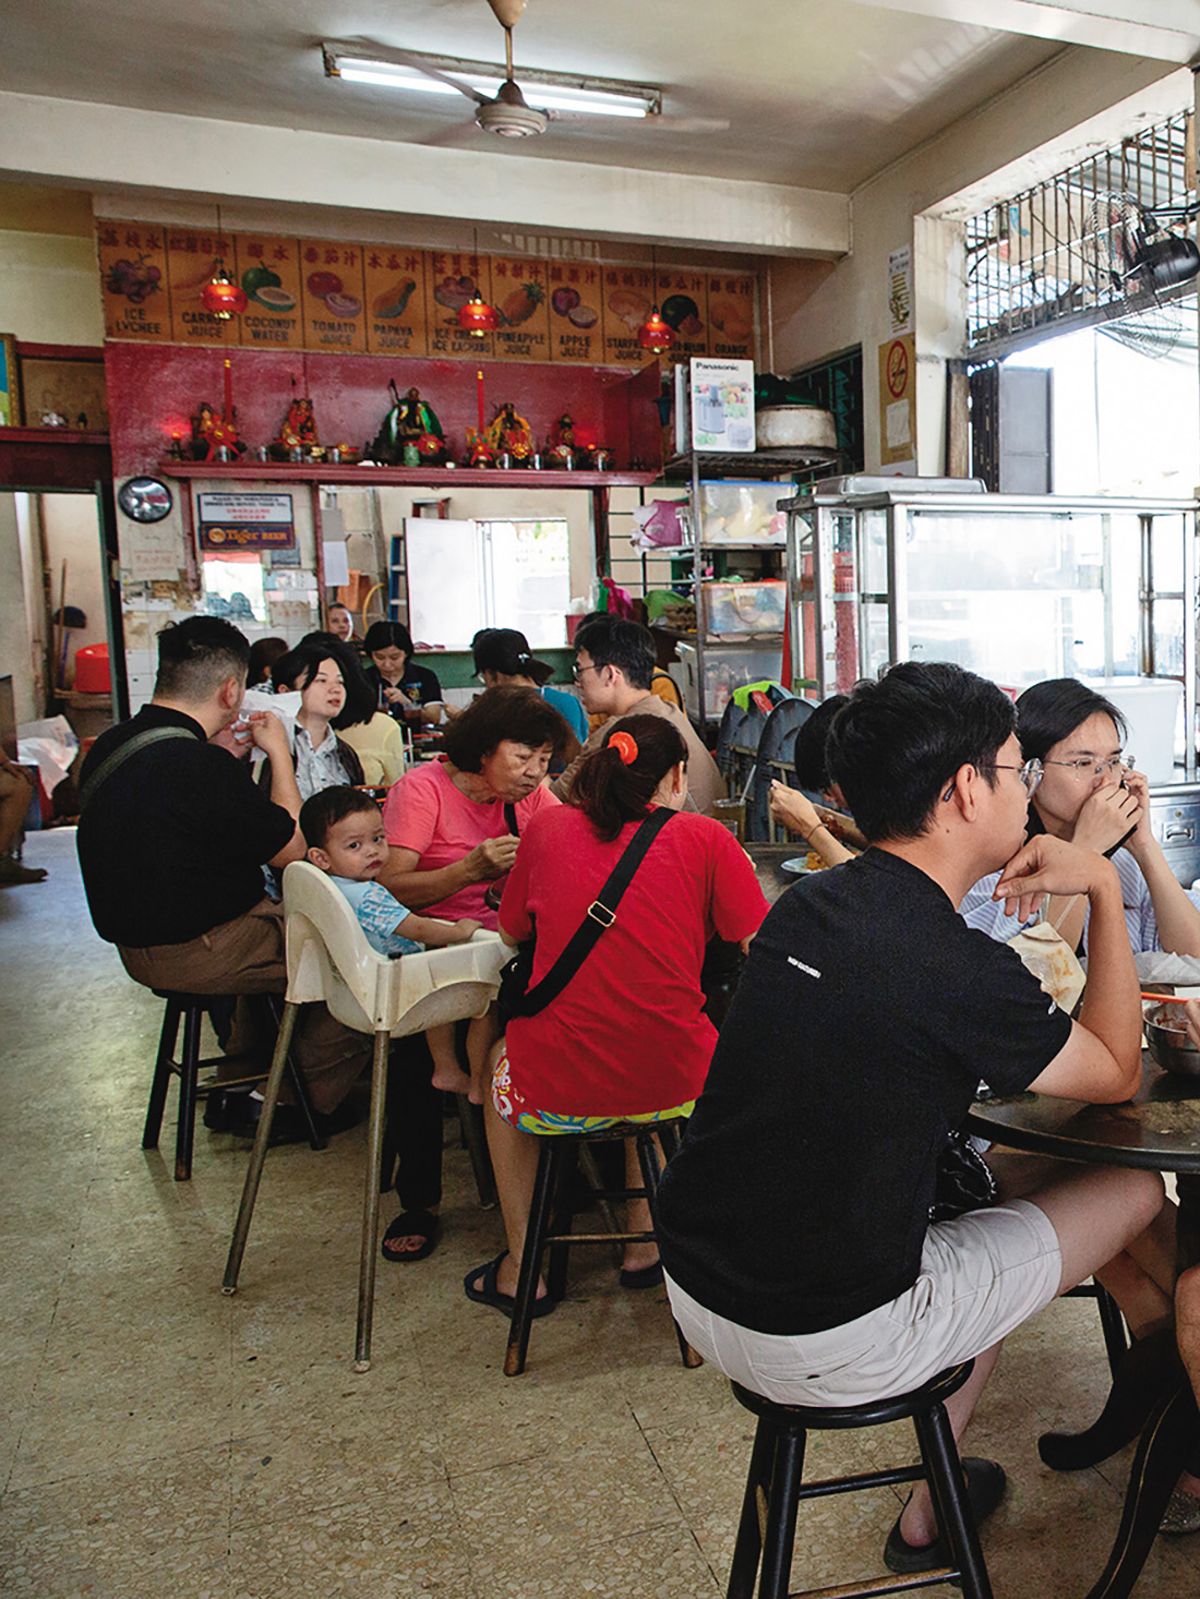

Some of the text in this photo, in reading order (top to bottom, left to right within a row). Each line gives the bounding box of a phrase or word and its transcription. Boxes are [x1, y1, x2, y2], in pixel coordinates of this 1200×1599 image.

[124, 308, 147, 321] ICE
[115, 320, 161, 335] LYCHEE
[244, 316, 297, 330] COCONUT
[311, 319, 357, 333] TOMATO
[187, 324, 223, 338] JUICE
[251, 328, 289, 342] WATER
[373, 323, 414, 337] PAPAYA
[319, 332, 353, 346] JUICE
[378, 336, 410, 349] JUICE
[496, 332, 545, 345] PINEAPPLE
[559, 335, 591, 347] APPLE
[504, 344, 531, 356] JUICE
[560, 347, 590, 358] JUICE
[615, 350, 643, 361] JUICE
[714, 344, 748, 354] ORANGE
[696, 362, 739, 372] Panasonic
[226, 528, 287, 544] Tiger BEER
